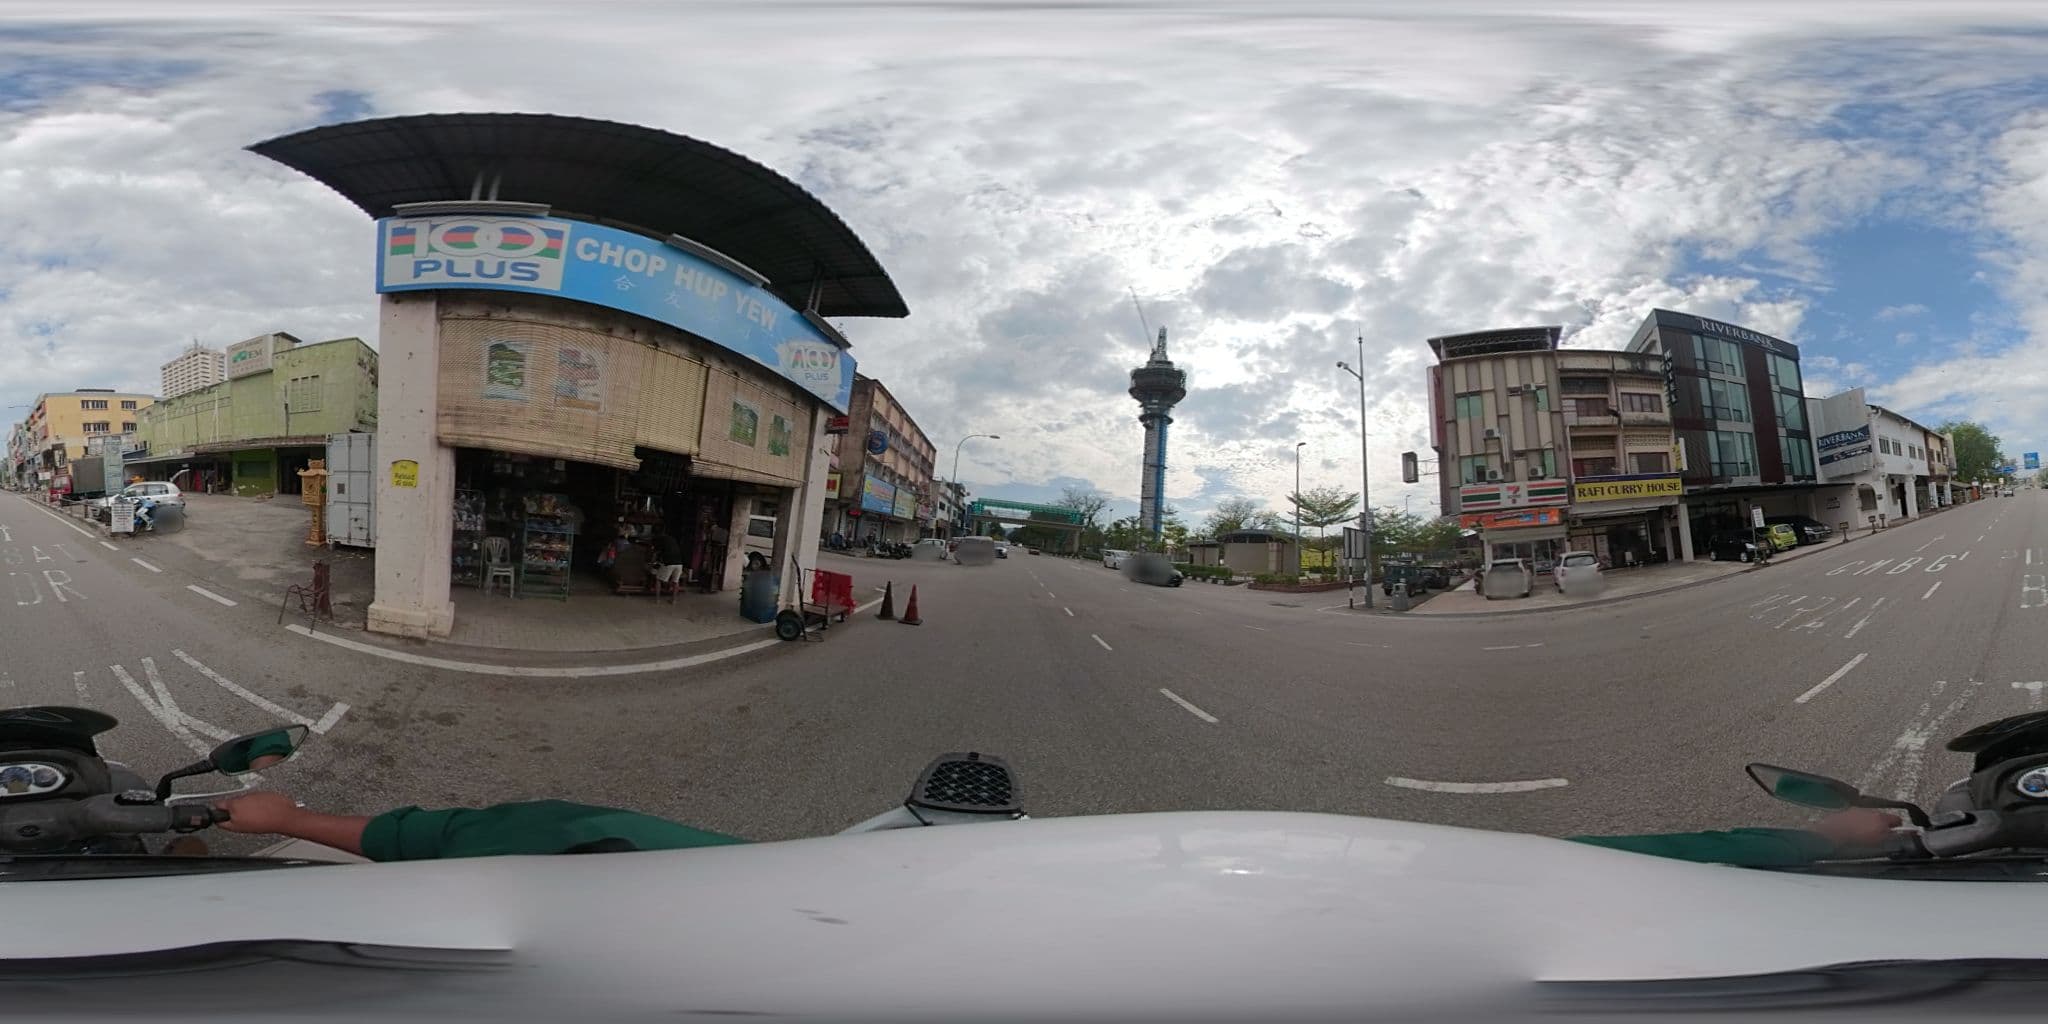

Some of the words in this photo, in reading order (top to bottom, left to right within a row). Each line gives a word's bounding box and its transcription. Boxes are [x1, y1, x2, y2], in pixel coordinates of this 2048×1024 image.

[404, 218, 549, 259] 100
[413, 259, 541, 282] PLUS
[575, 237, 667, 277] CHOP
[674, 263, 729, 299] HUP
[735, 289, 778, 331] YEW
[1700, 319, 1774, 348] RIVERBANK
[804, 372, 830, 382] PLUS
[1818, 431, 1865, 448] RIVERBANK
[1577, 486, 1605, 498] RAFI
[1607, 484, 1644, 497] CURRY
[1646, 481, 1681, 493] HOUSE
